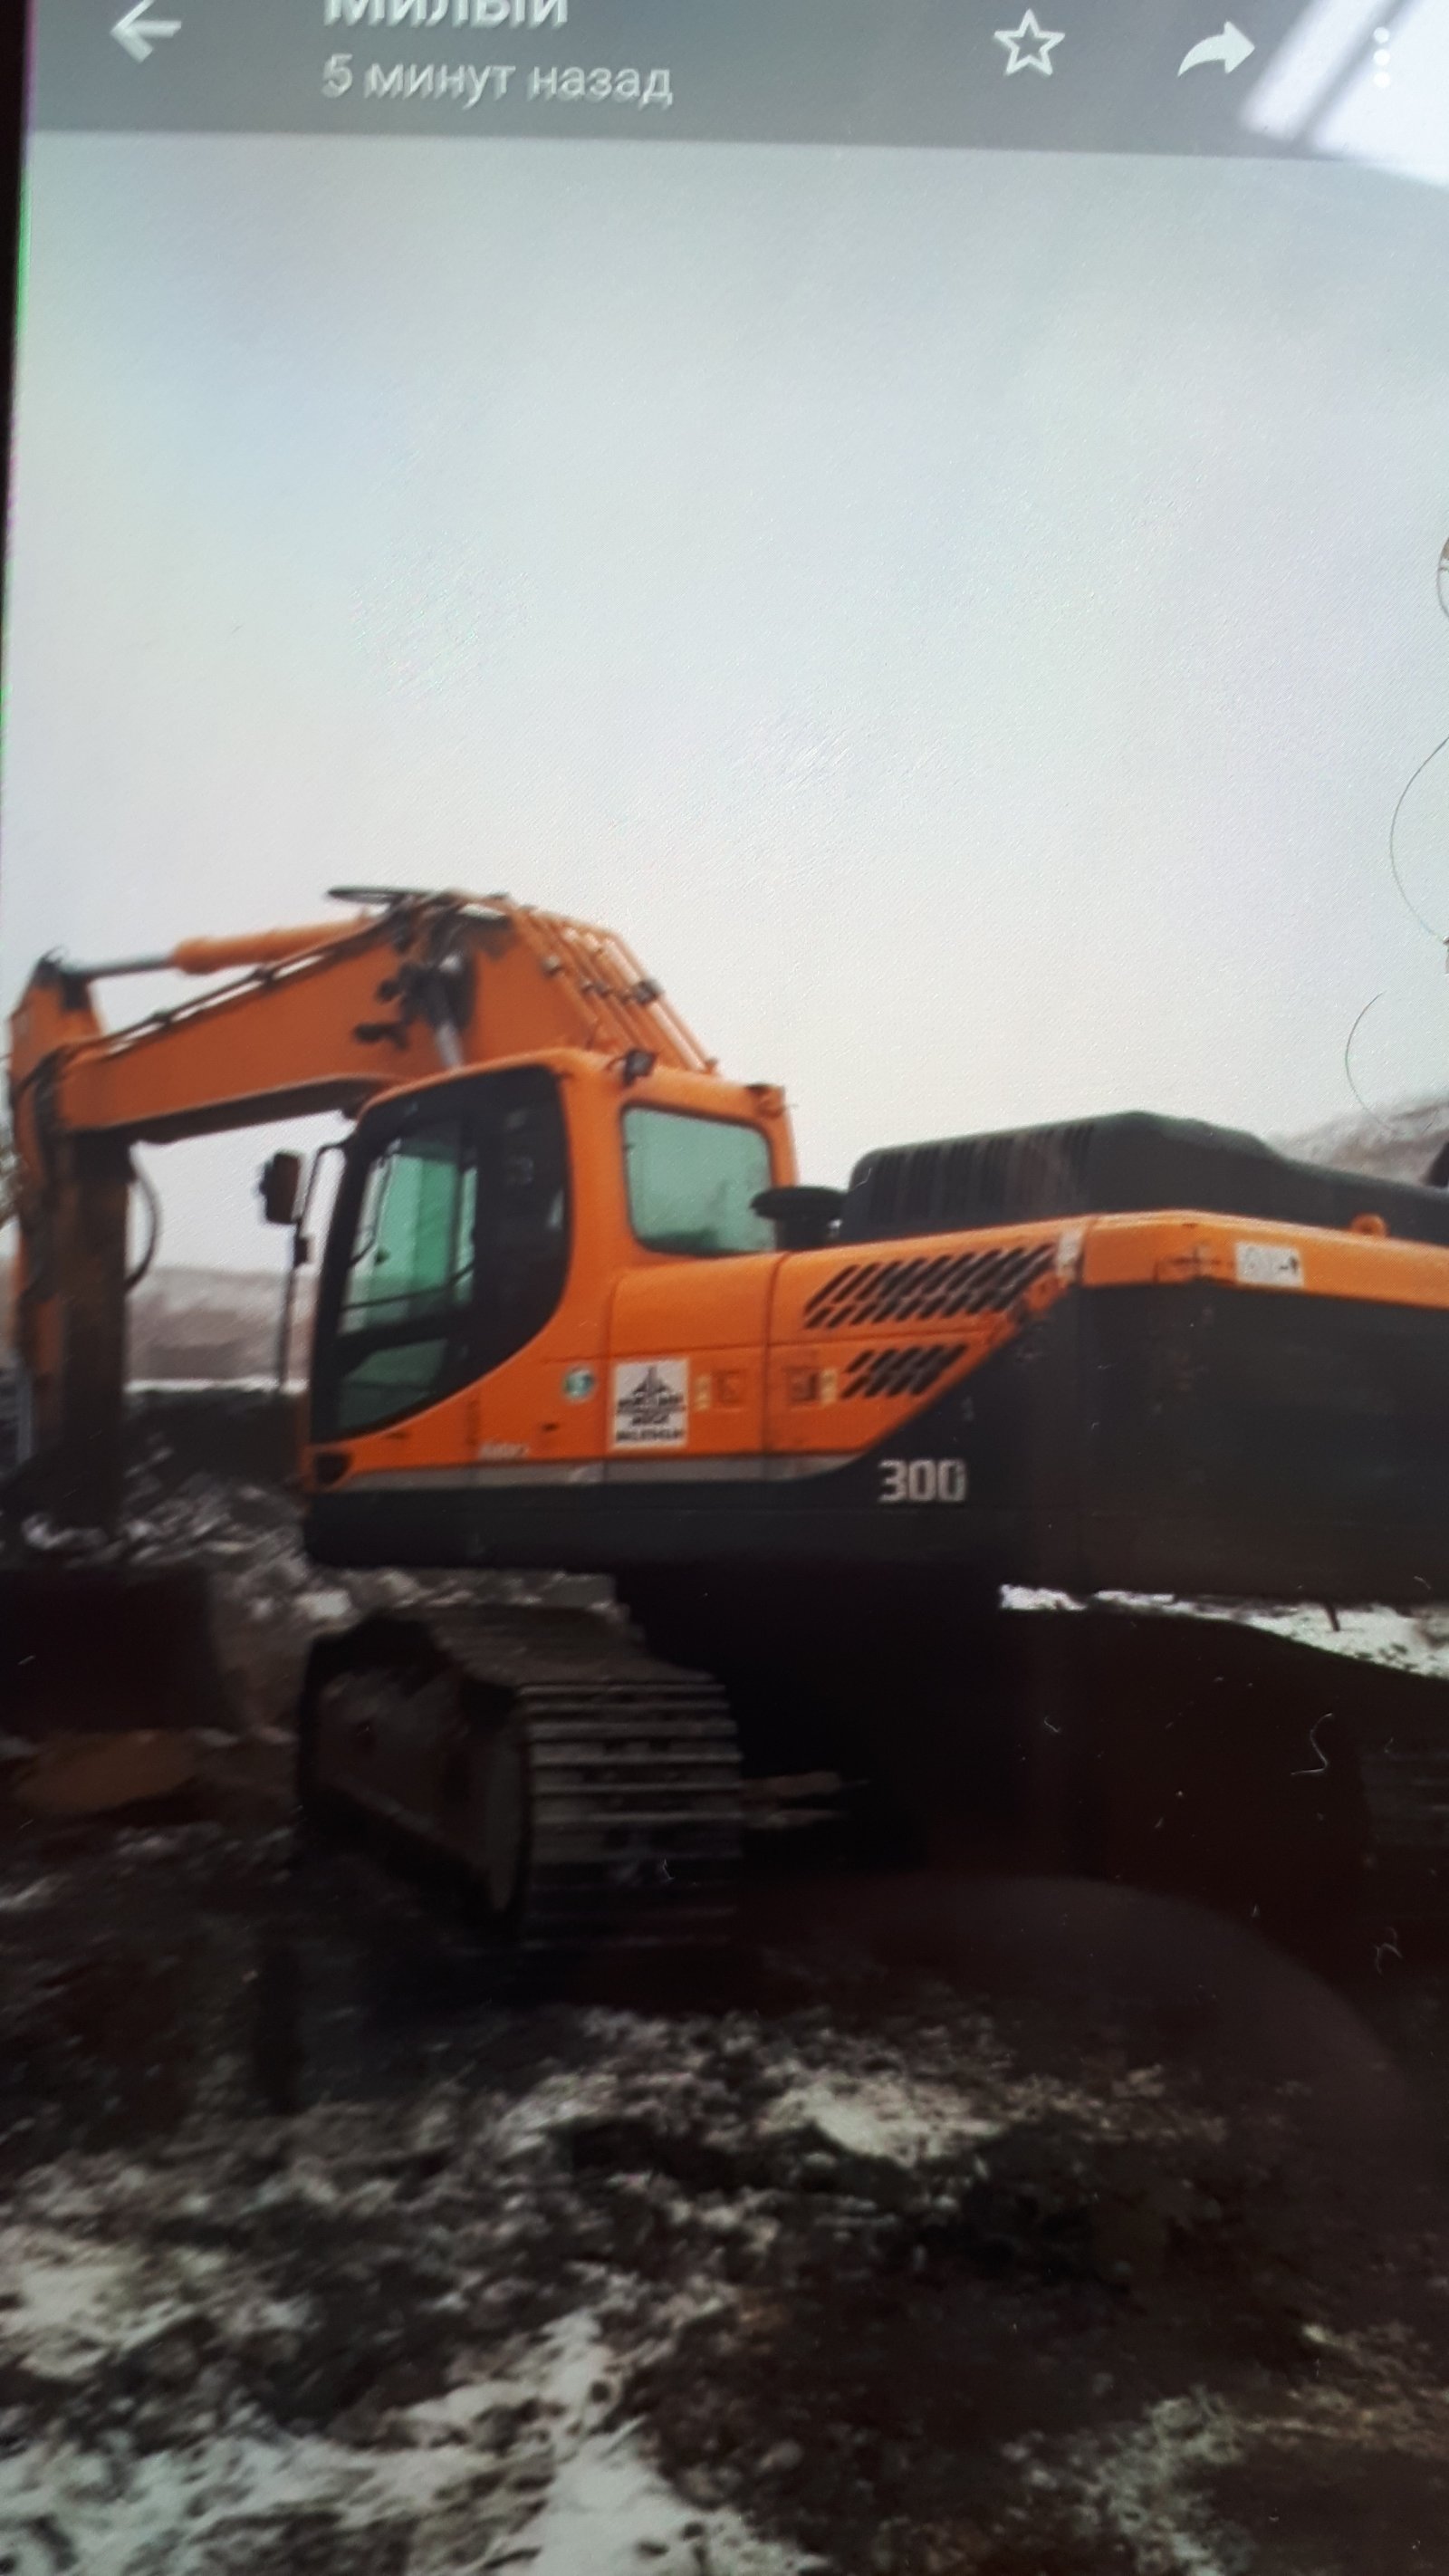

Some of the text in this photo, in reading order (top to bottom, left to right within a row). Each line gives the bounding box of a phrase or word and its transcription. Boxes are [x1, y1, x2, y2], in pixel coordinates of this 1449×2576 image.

[322, 53, 674, 110] 5 минут назад
[878, 1458, 966, 1504] 300
